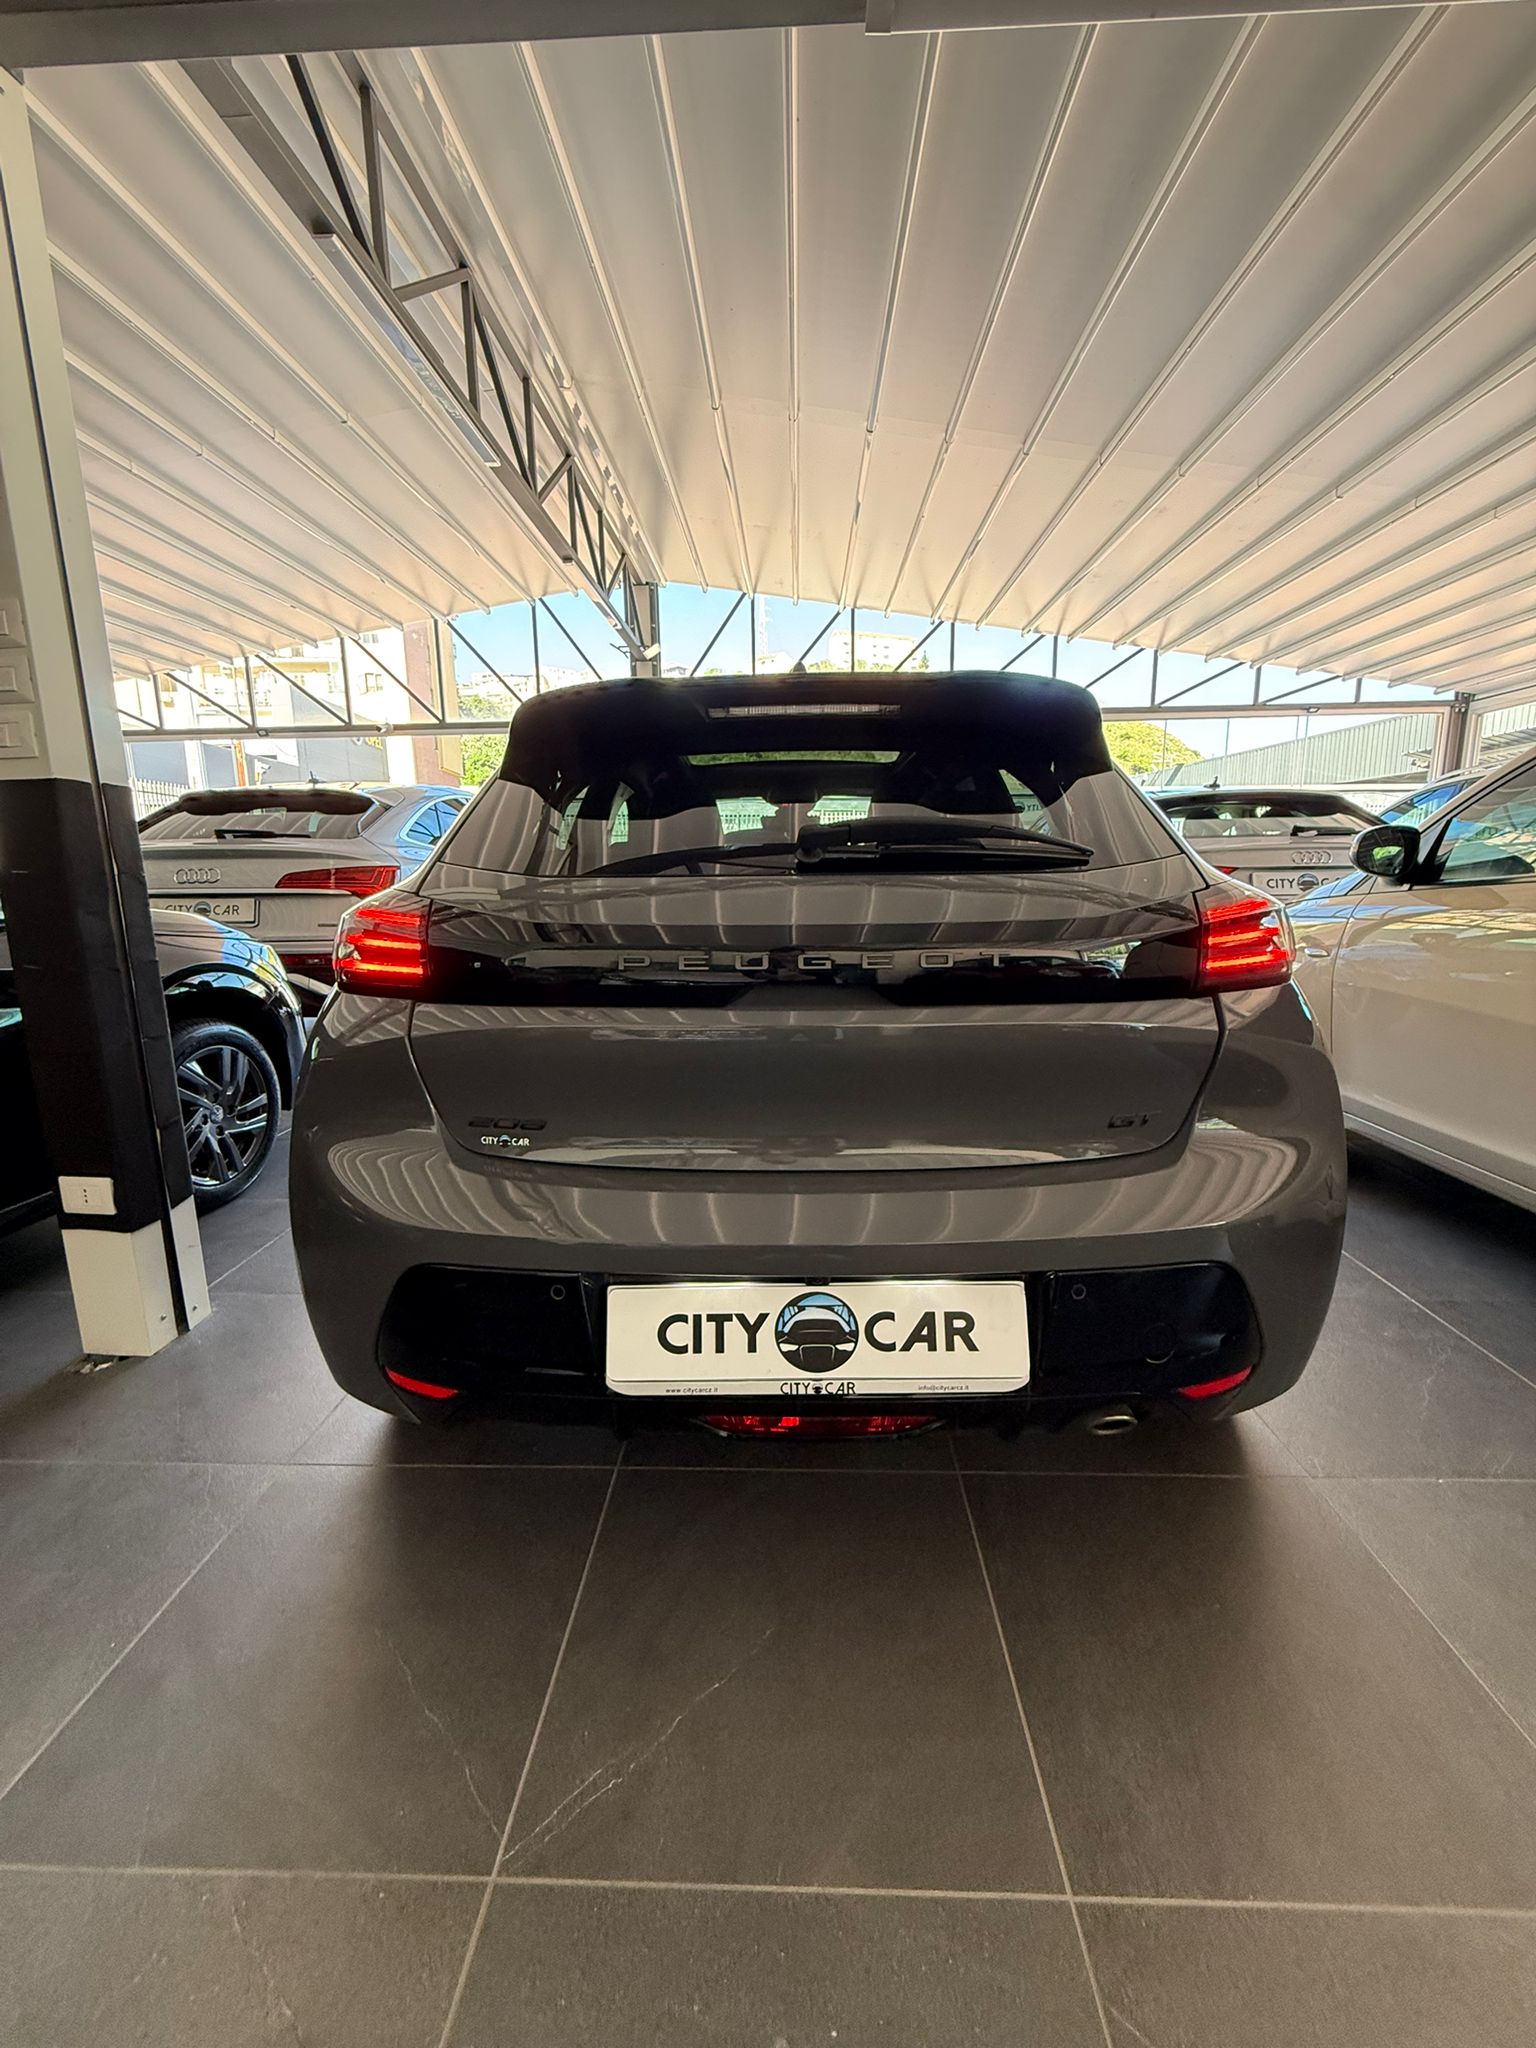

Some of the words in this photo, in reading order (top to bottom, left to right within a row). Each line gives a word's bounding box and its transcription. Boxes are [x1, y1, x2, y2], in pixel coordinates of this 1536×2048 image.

[1266, 878, 1295, 888] CITY
[213, 904, 240, 915] CAR
[617, 951, 1011, 970] PEUGEOT
[480, 1136, 499, 1144] CITY
[511, 1137, 530, 1146] CAR
[657, 1312, 770, 1354] CITY
[863, 1311, 980, 1352] CAR
[780, 1382, 811, 1395] CITY
[824, 1381, 856, 1394] CAR
